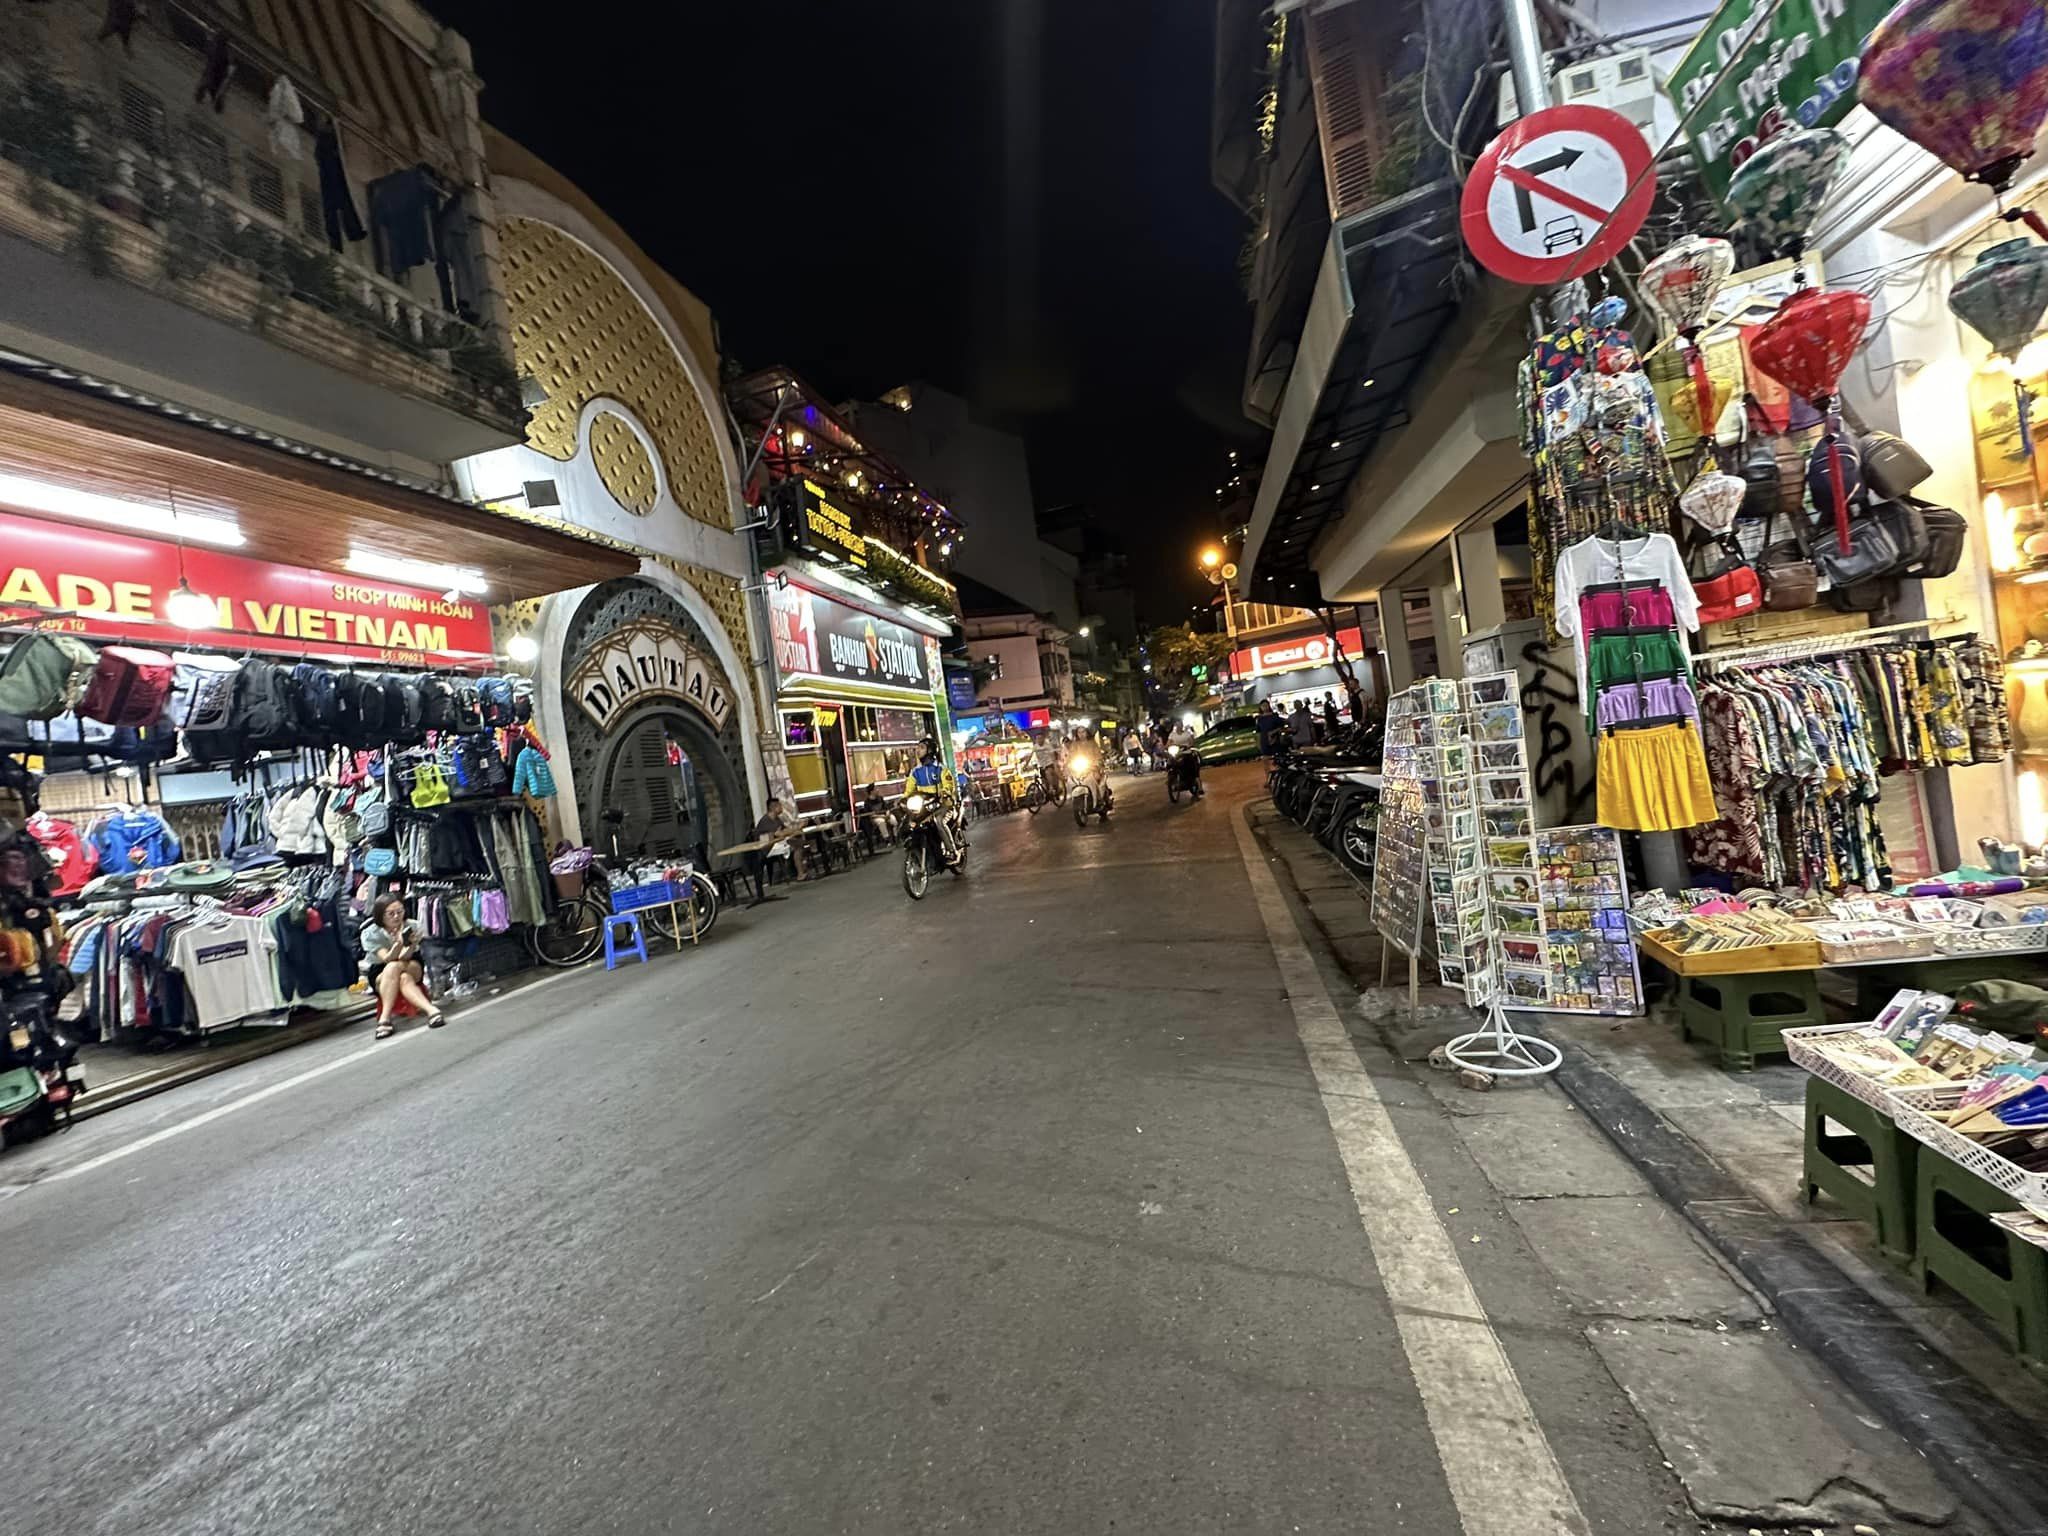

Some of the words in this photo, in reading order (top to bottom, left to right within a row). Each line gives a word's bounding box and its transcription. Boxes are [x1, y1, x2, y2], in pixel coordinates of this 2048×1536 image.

[334, 584, 382, 605] SHOP
[387, 592, 429, 613] MINH
[244, 601, 449, 650] VIETNAM
[829, 633, 868, 669] BANHMI
